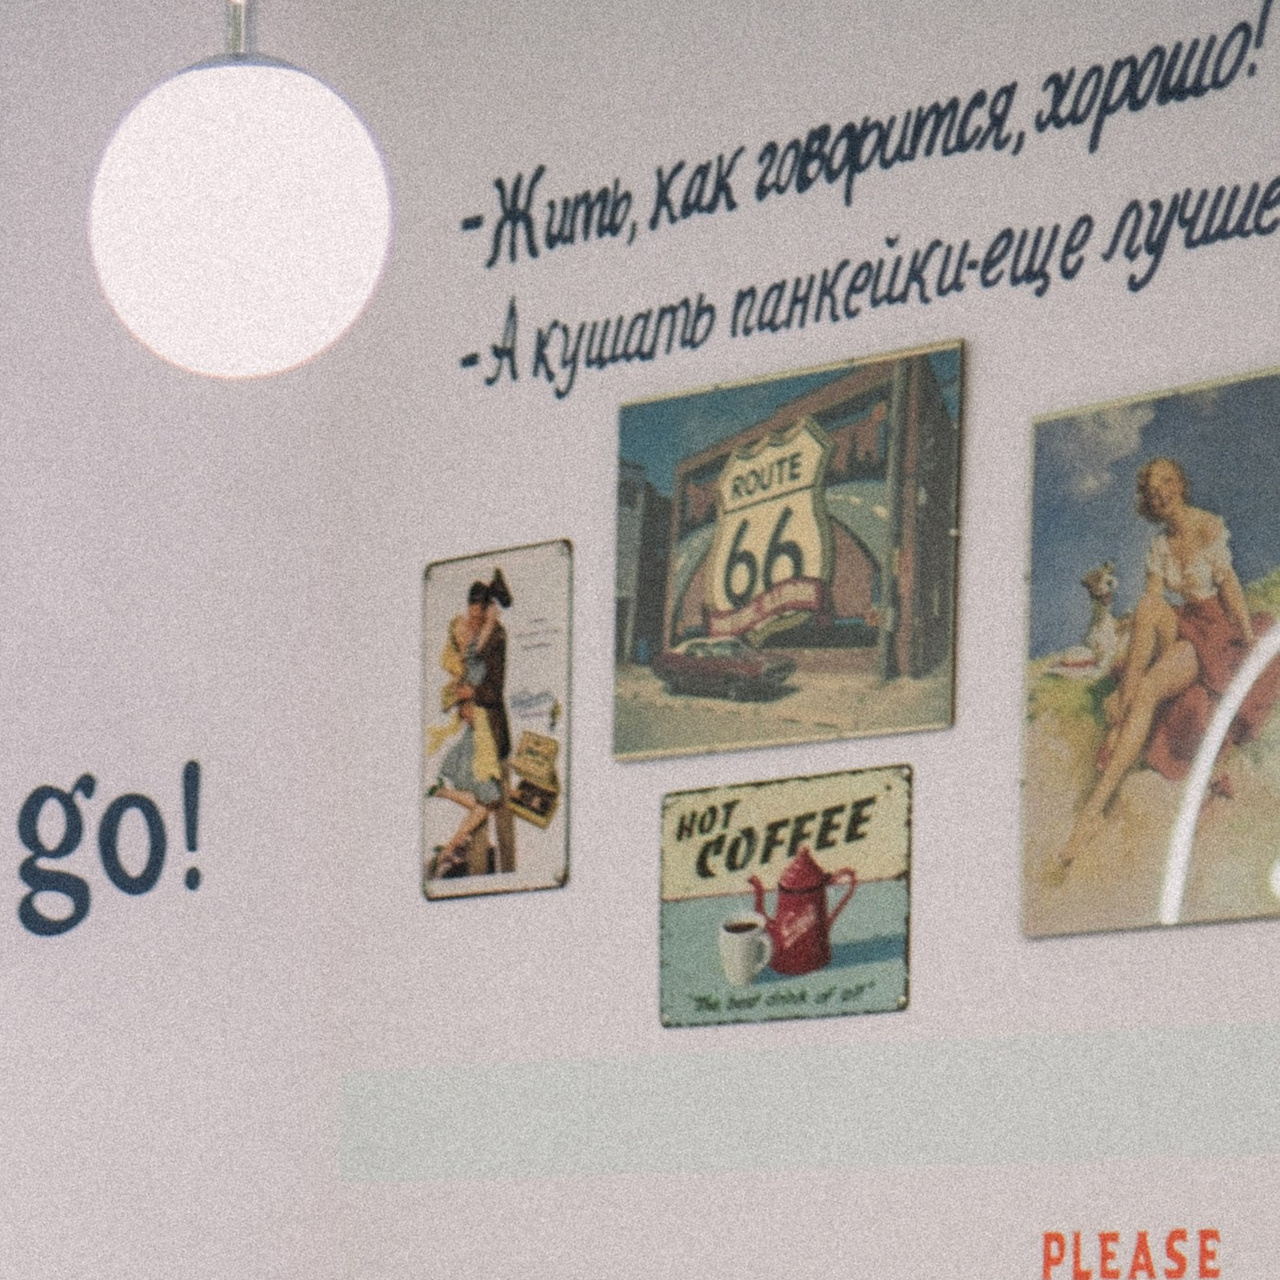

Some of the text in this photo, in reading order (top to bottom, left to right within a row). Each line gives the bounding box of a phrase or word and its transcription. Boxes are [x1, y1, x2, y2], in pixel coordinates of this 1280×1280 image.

[1035, 0, 1271, 153] хорошо!
[731, 451, 801, 500] ROUTE
[724, 506, 805, 609] 66
[18, 760, 202, 936] go!
[676, 799, 741, 842] HOT
[695, 796, 878, 879] COFFEE
